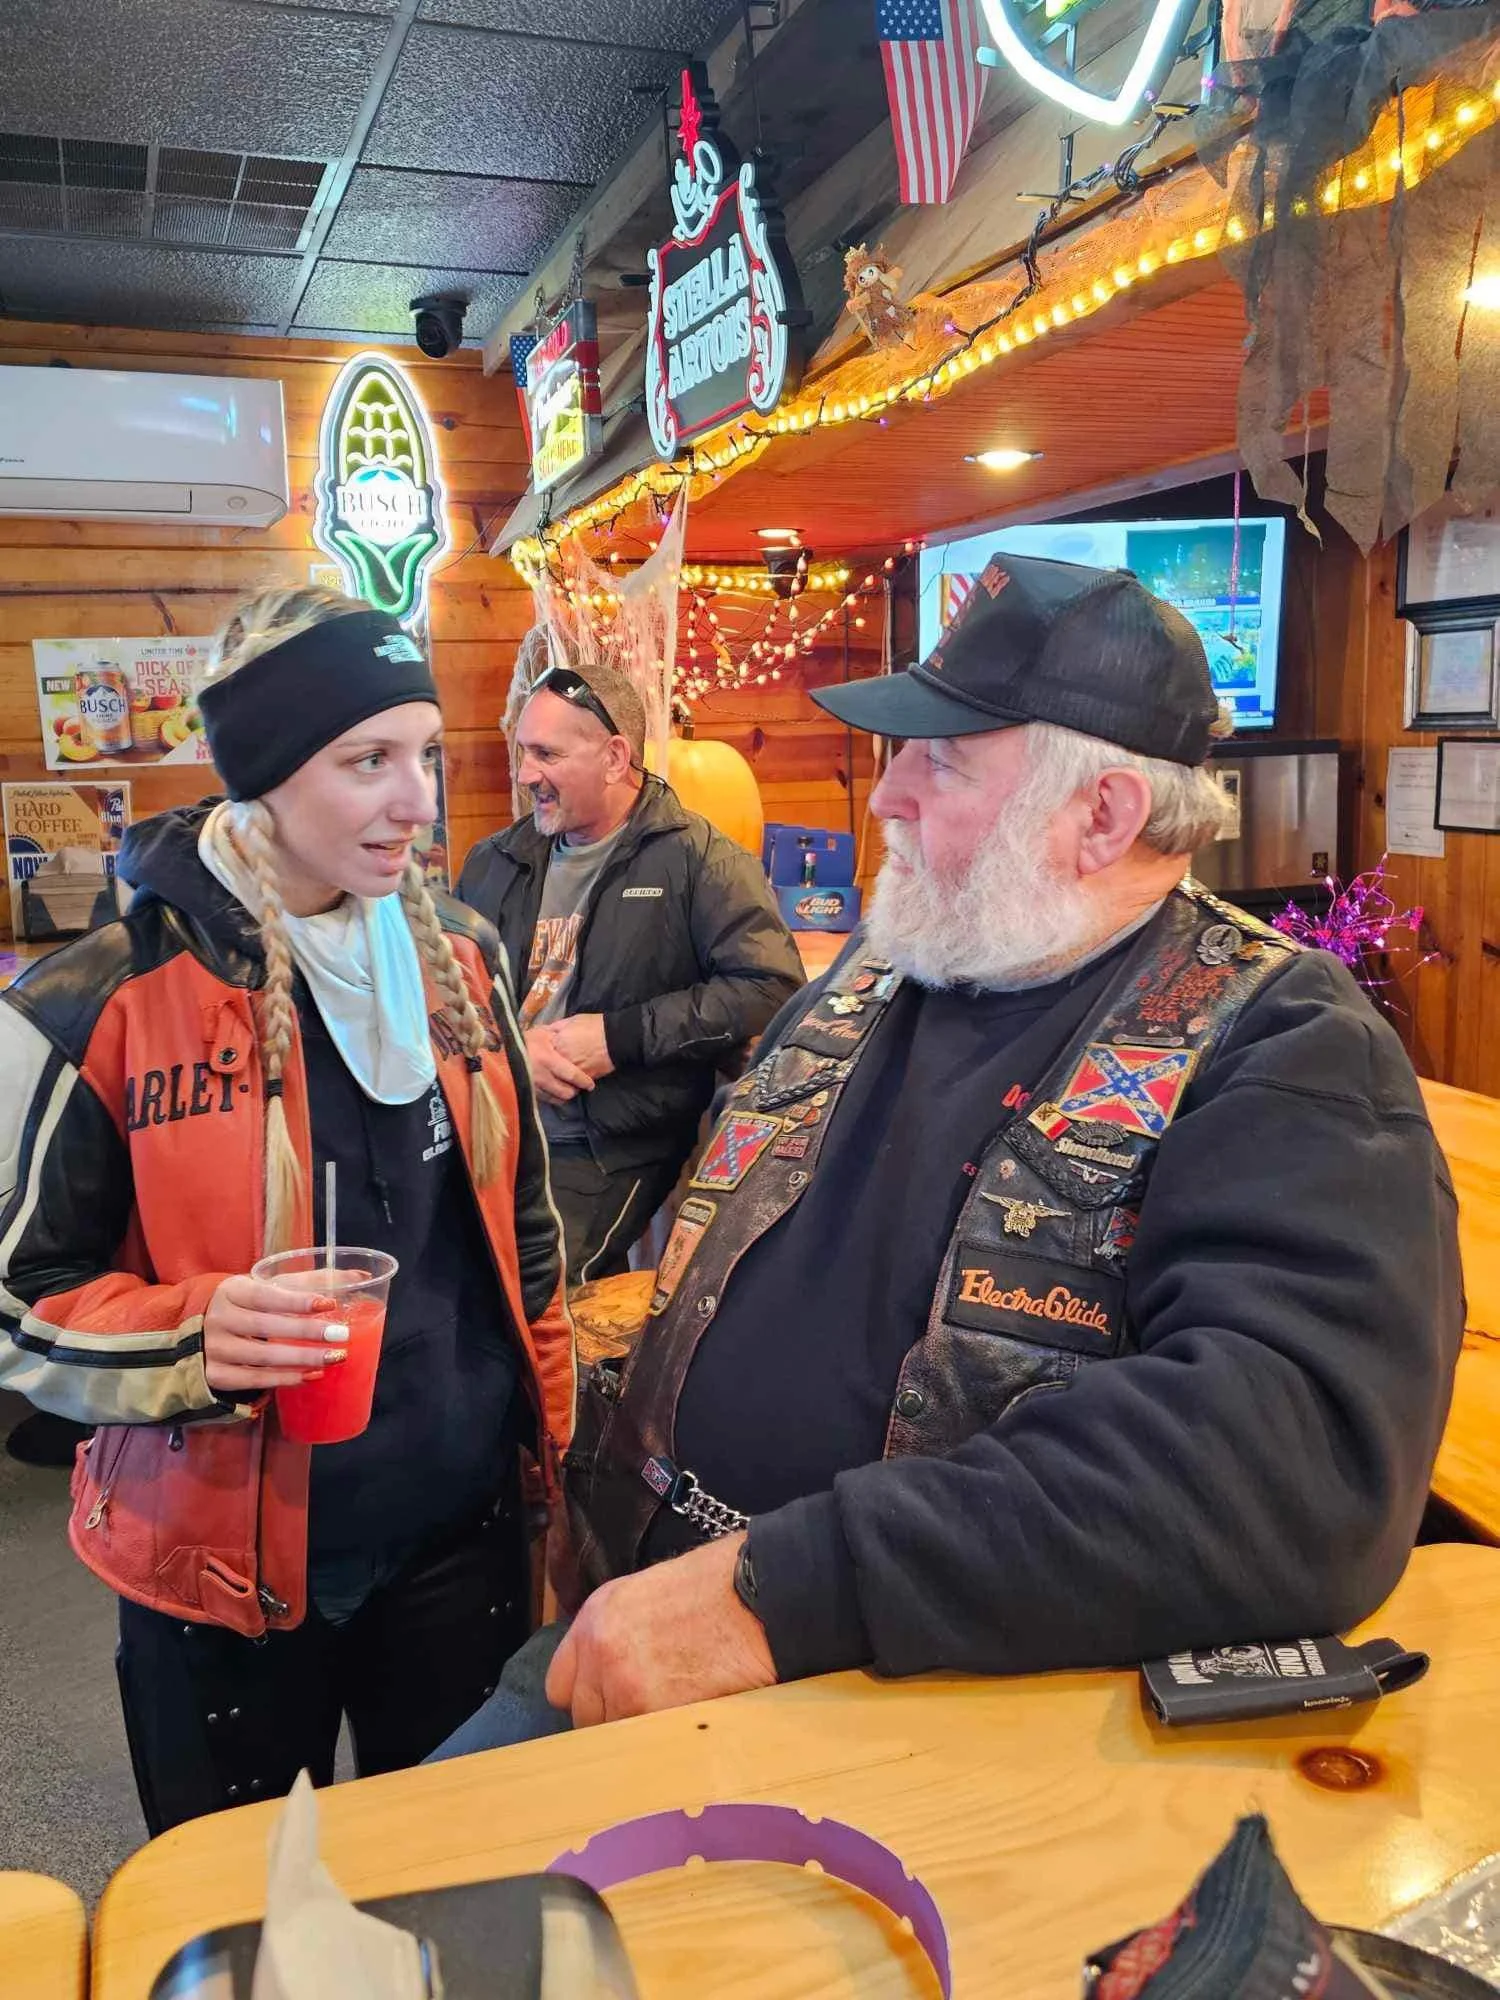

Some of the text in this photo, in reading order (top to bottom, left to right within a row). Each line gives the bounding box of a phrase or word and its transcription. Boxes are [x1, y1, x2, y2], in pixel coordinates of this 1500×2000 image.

[662, 232, 750, 340] STELLA
[668, 297, 752, 399] ARTOIS
[341, 490, 423, 516] BUSCH
[135, 660, 171, 685] PICK
[46, 679, 71, 692] NEW
[144, 677, 193, 696] SEAS
[79, 698, 126, 714] BUSCH
[14, 801, 62, 818] HARD
[14, 819, 82, 834] COFFEE
[800, 904, 843, 915] LIGHT
[809, 897, 840, 907] BUD
